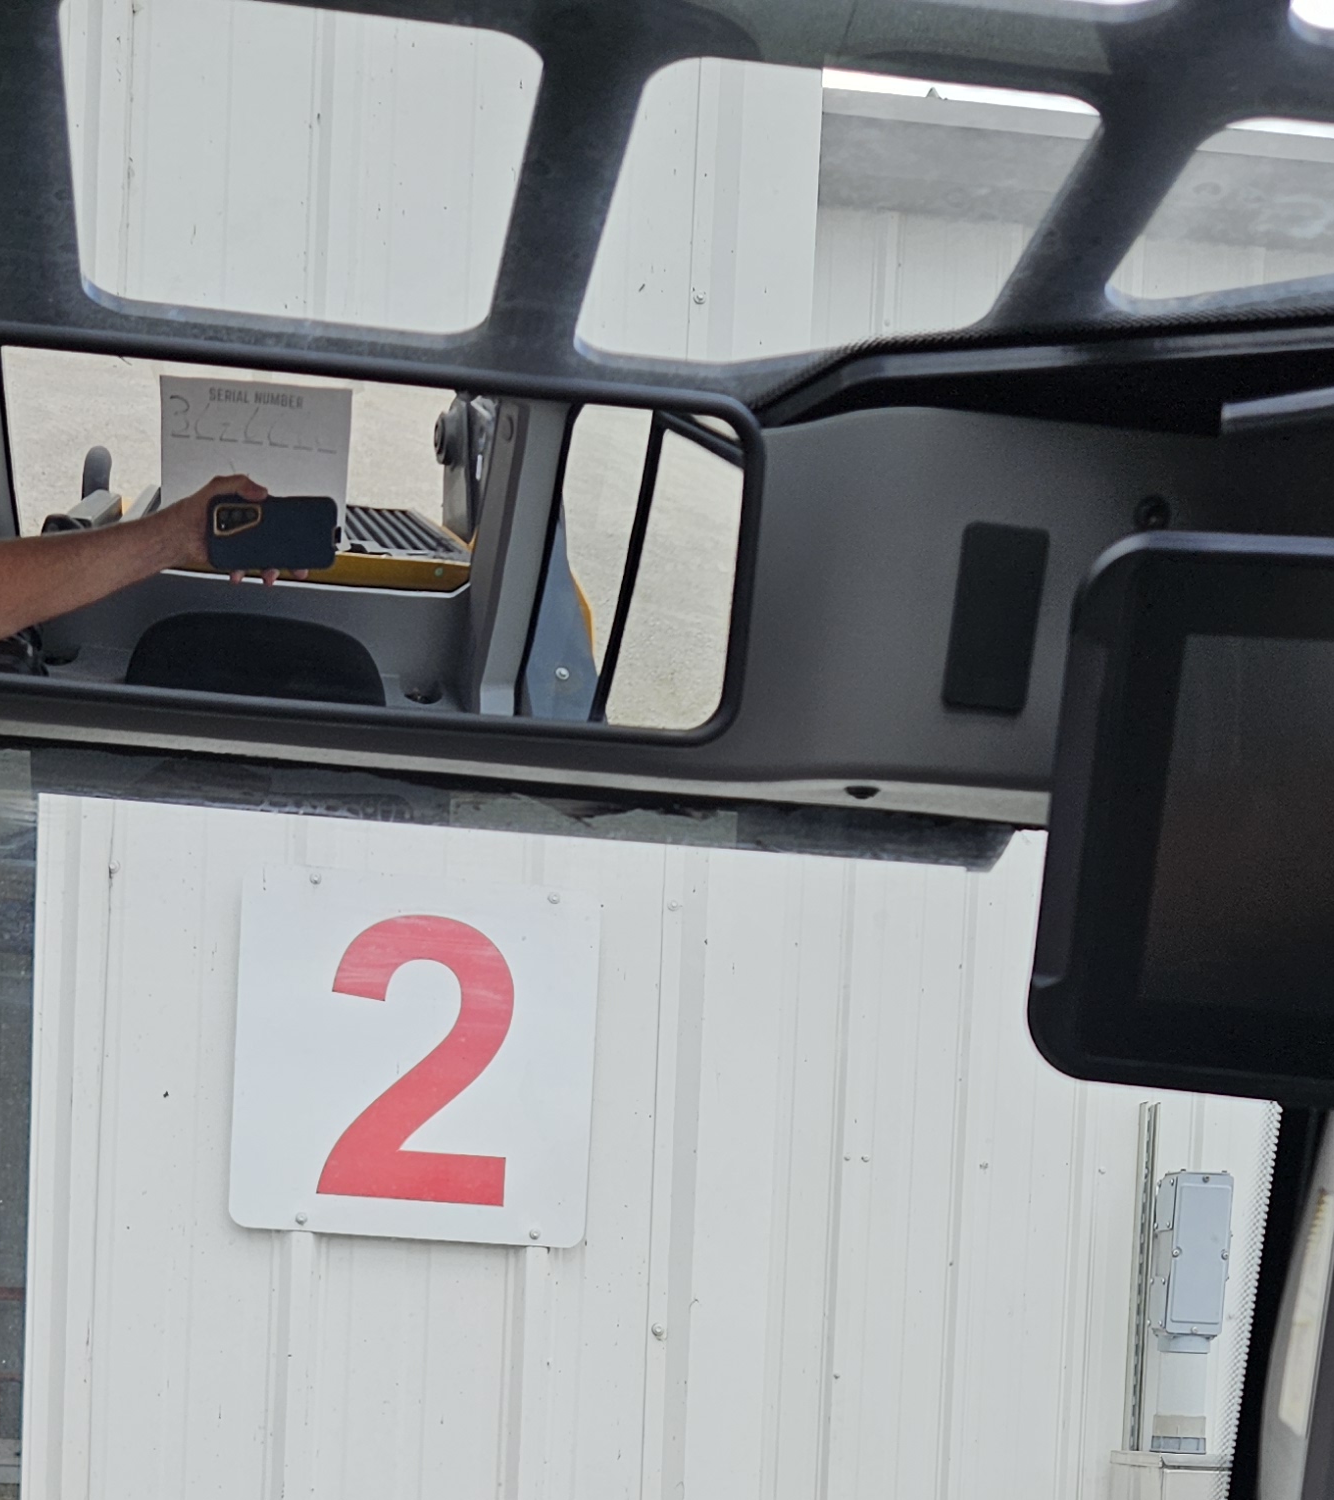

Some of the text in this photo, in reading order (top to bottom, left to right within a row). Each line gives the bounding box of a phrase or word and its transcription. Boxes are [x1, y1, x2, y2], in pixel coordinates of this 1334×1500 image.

[208, 386, 304, 409] SERIAL NUMBER
[316, 914, 515, 1207] 2
